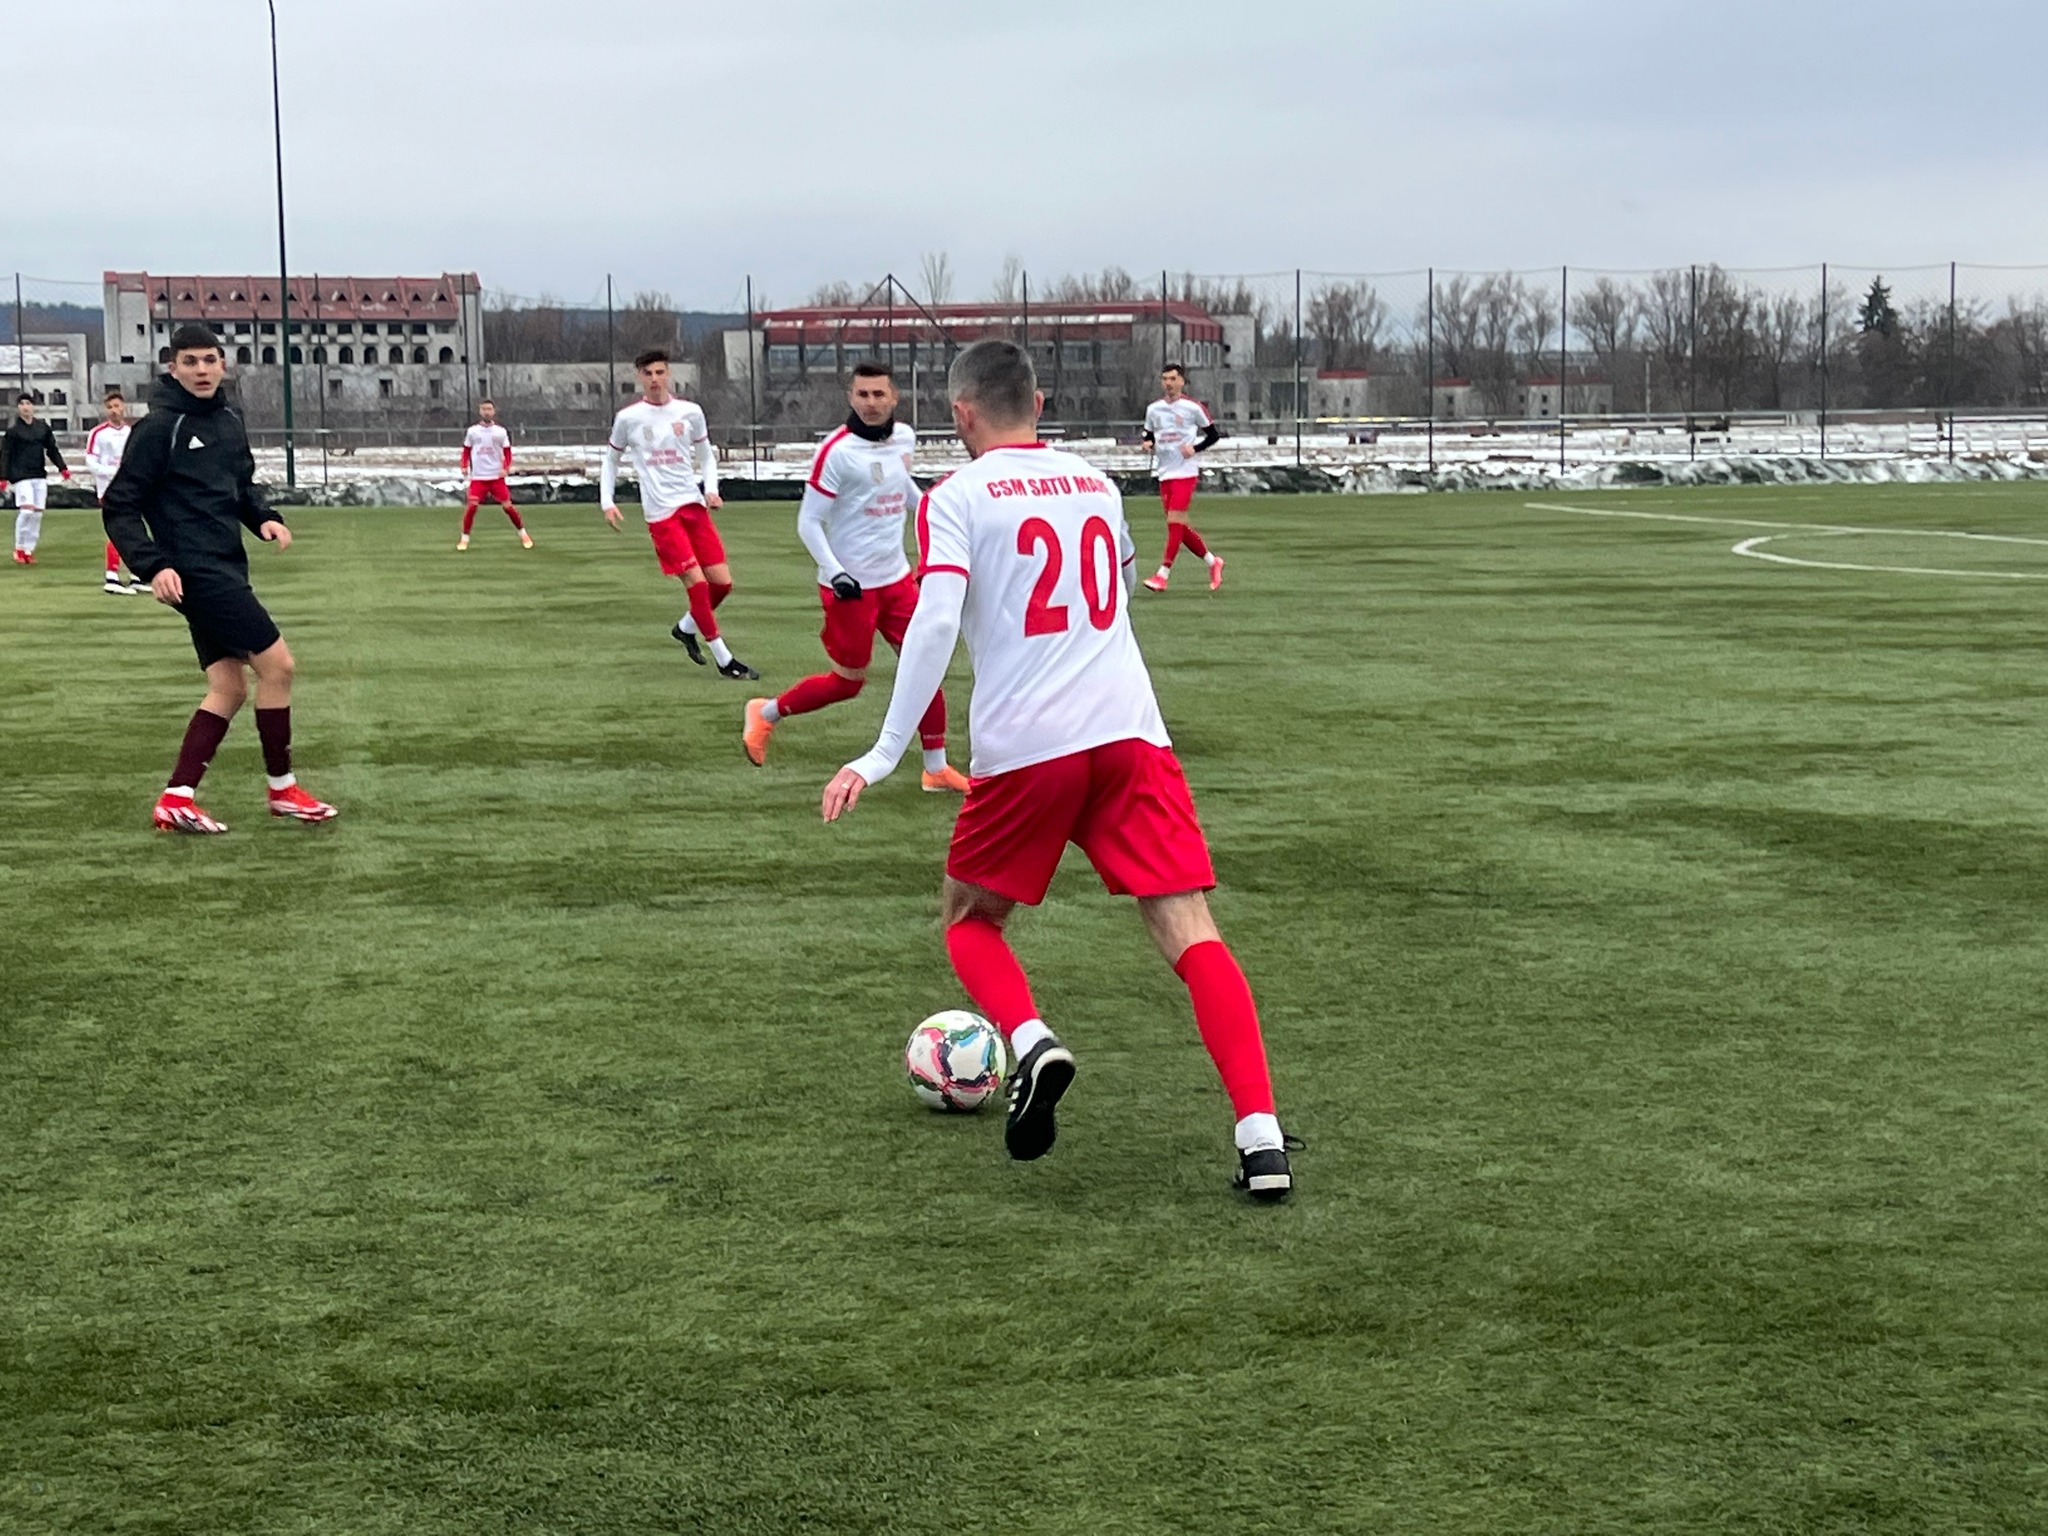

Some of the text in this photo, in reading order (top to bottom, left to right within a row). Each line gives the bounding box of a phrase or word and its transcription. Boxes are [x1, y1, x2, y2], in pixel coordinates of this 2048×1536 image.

[986, 478, 1028, 499] CSM
[1027, 476, 1072, 497] SATU
[1017, 515, 1117, 637] 20
